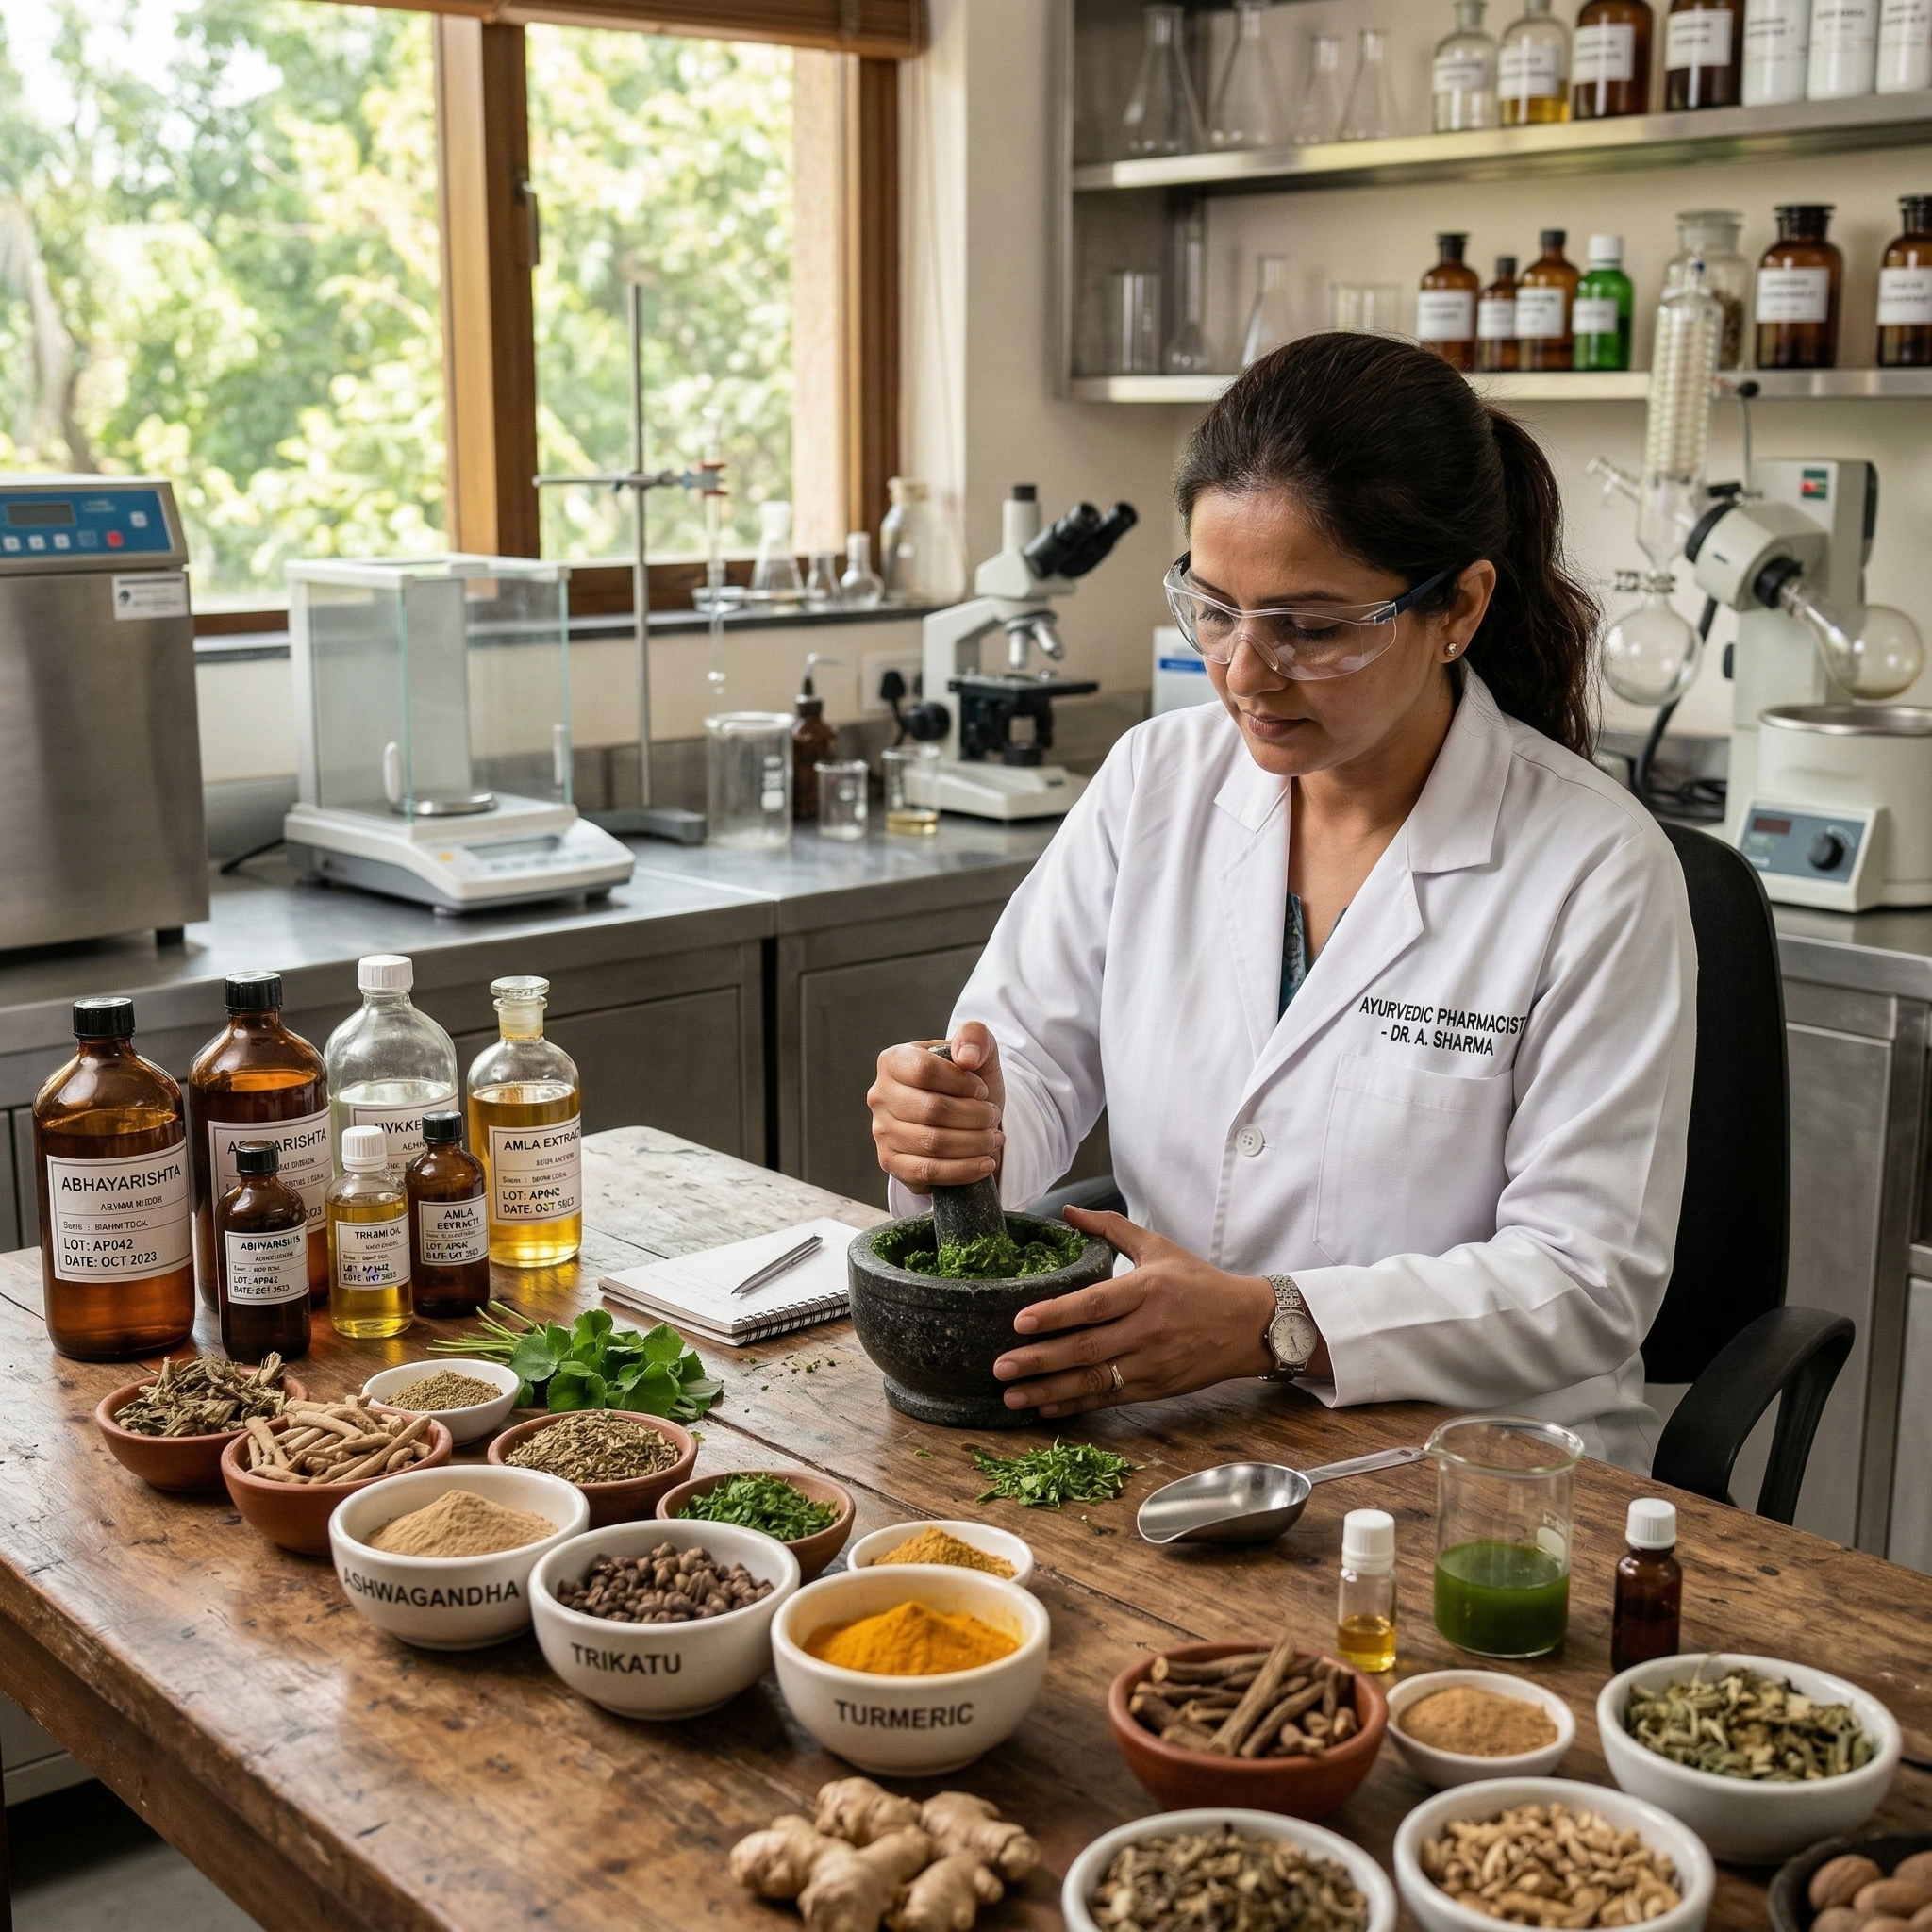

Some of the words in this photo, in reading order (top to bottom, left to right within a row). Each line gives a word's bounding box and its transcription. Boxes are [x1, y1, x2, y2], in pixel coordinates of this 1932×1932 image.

[1359, 996, 1434, 1024] AYURVEDIC
[1436, 1008, 1527, 1035] PHARMACIST
[1391, 1024, 1411, 1044] DR.
[1414, 1028, 1428, 1046] A.
[1433, 1030, 1494, 1056] SHARMA
[504, 1140, 541, 1151] AMLA
[61, 1163, 181, 1192] ABHAYARISHTA
[503, 1190, 526, 1201] LOT:
[444, 1208, 474, 1220] AMLA
[64, 1238, 91, 1251] LOT:
[93, 1238, 134, 1252] AP042
[65, 1255, 98, 1268] DATE:
[101, 1255, 127, 1268] OCT
[130, 1251, 158, 1265] 2023
[343, 1567, 521, 1607] ASHWAGANDHA
[570, 1641, 682, 1675] TRIKATU
[834, 1699, 974, 1730] TURMERIC
